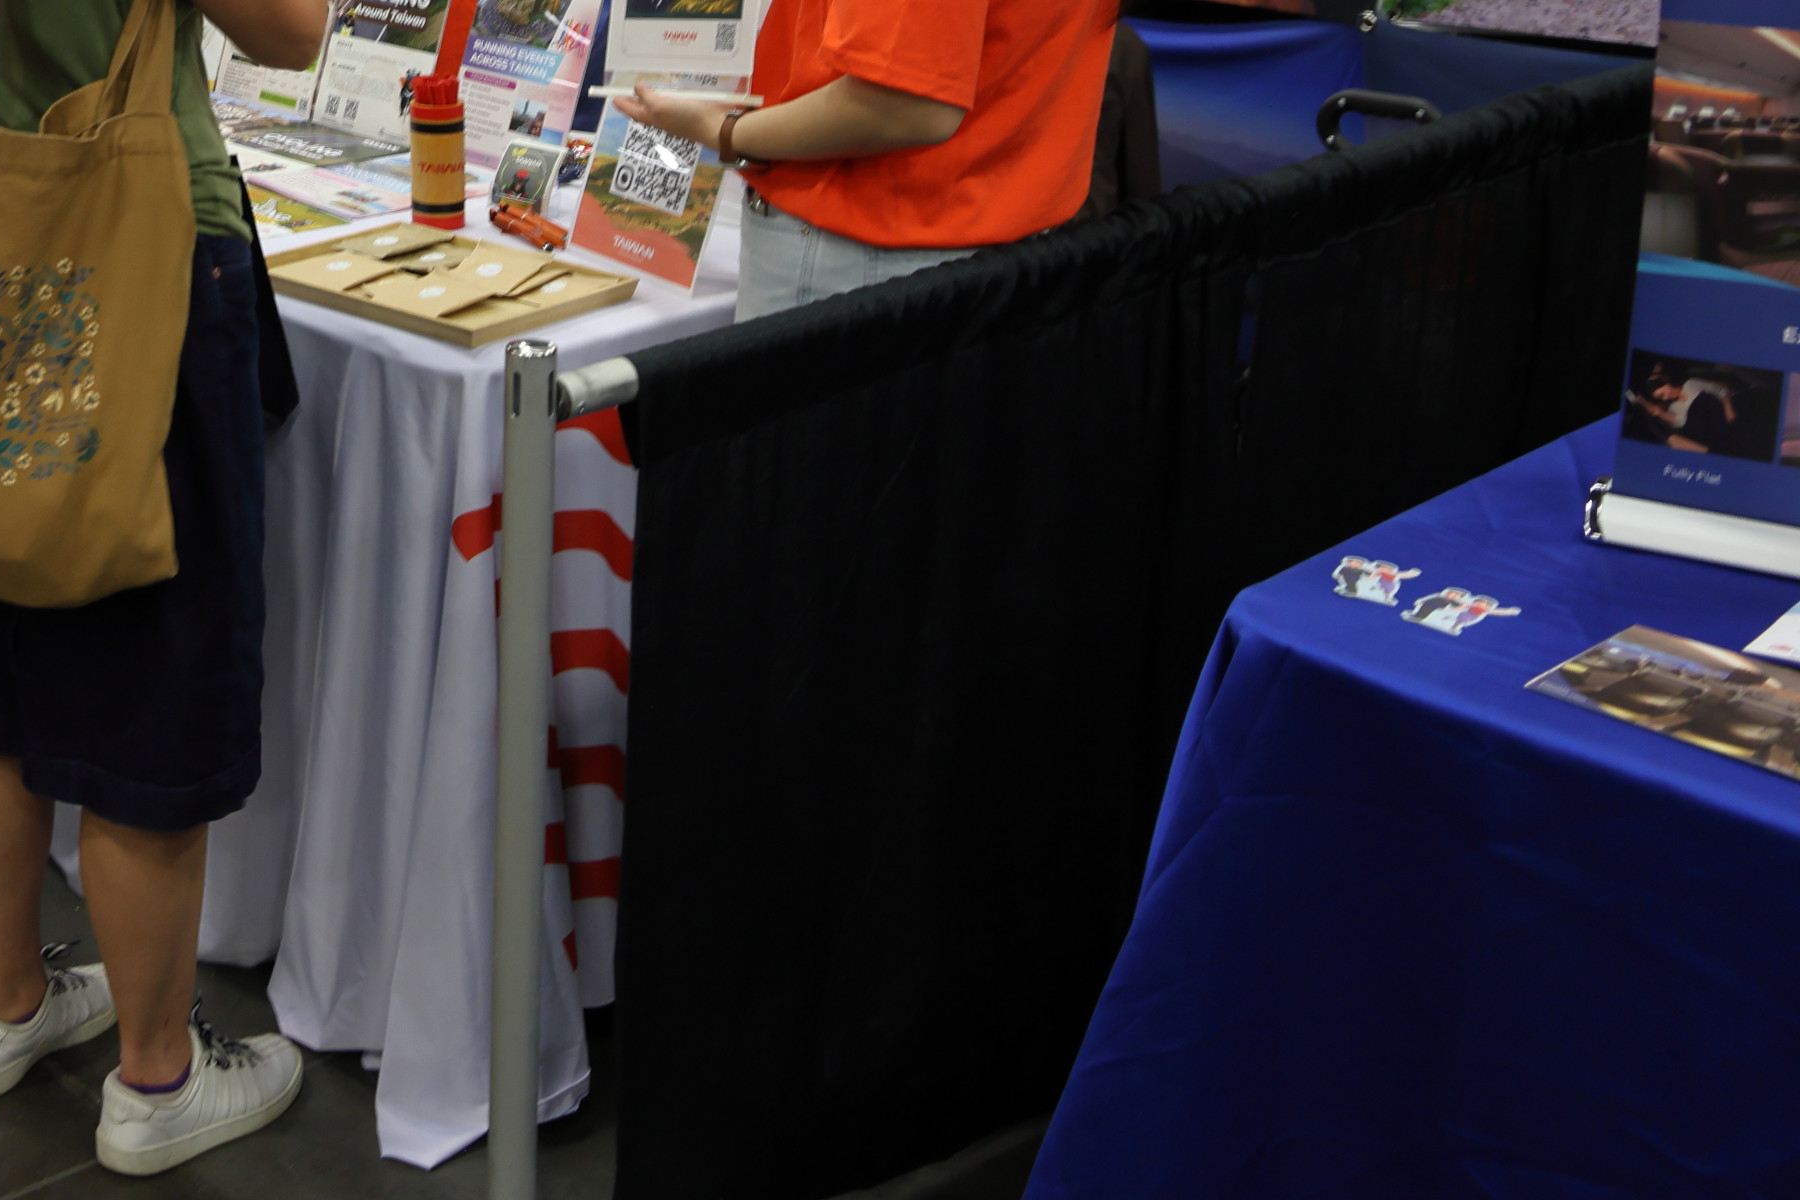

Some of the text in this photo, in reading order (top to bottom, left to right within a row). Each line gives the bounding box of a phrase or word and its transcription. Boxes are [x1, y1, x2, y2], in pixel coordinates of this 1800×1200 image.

[354, 2, 428, 29] Around Taiwan
[469, 52, 508, 71] ACROSS
[509, 59, 549, 80] TAIWAN
[472, 38, 557, 68] RUNNING EVENTS
[612, 233, 656, 260] TAIWAN
